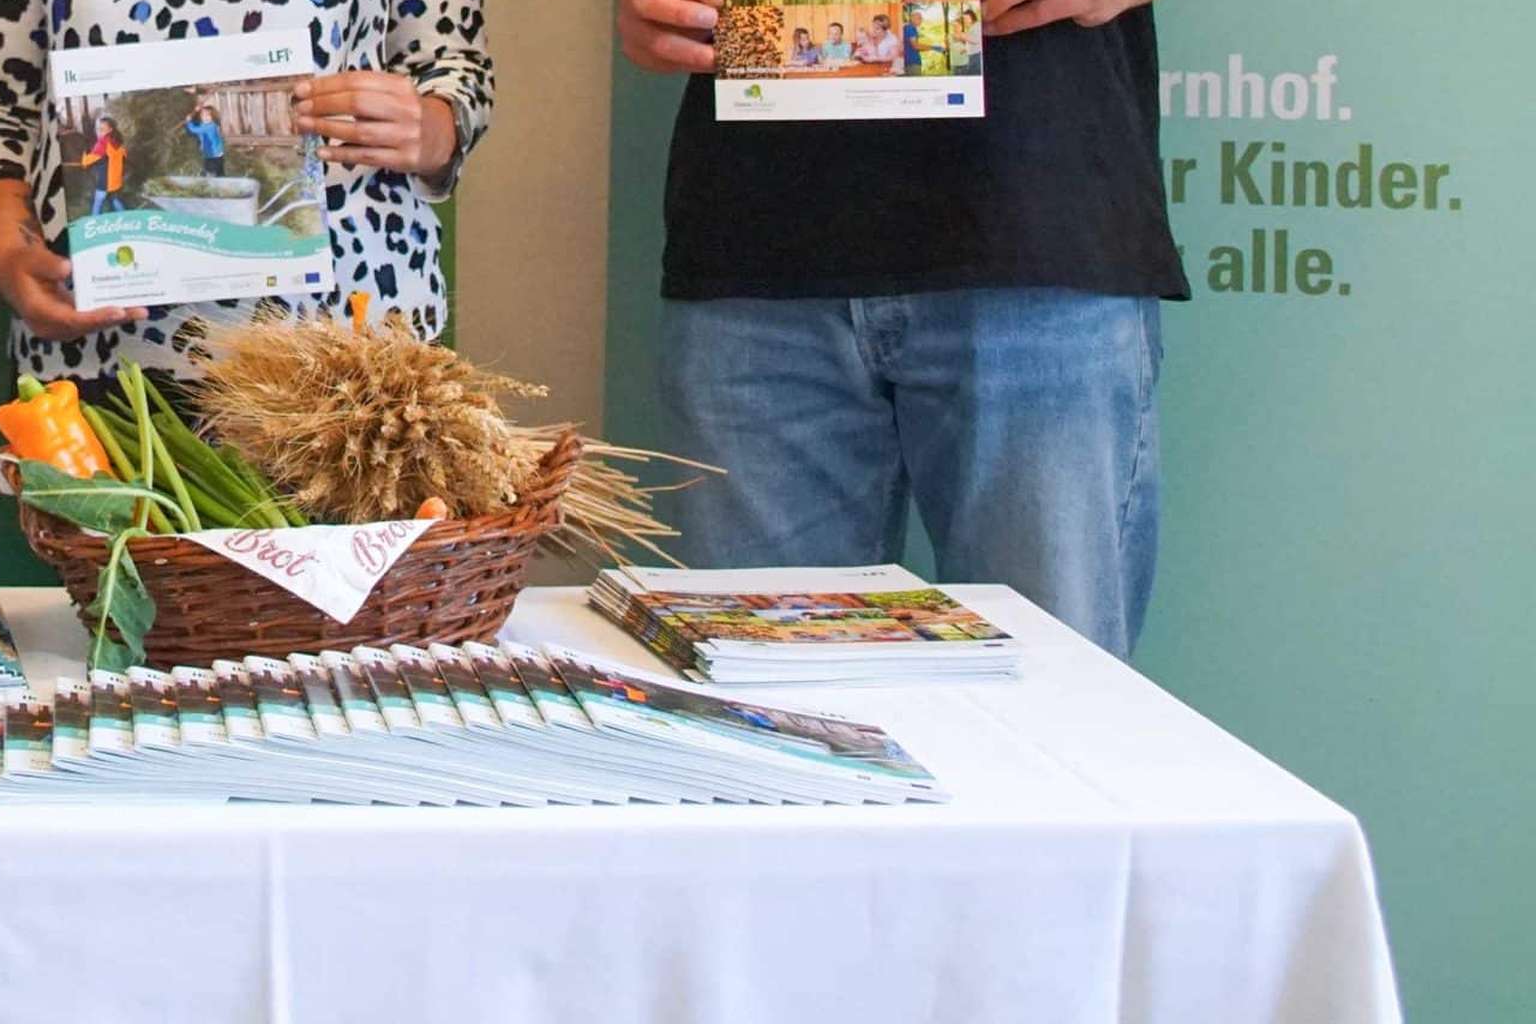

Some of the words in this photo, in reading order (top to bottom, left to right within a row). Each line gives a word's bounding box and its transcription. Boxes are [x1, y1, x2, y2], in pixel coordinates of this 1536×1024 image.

[1220, 140, 1462, 211] Kinder.
[1207, 228, 1352, 296] alle.
[223, 528, 318, 577] Brot
